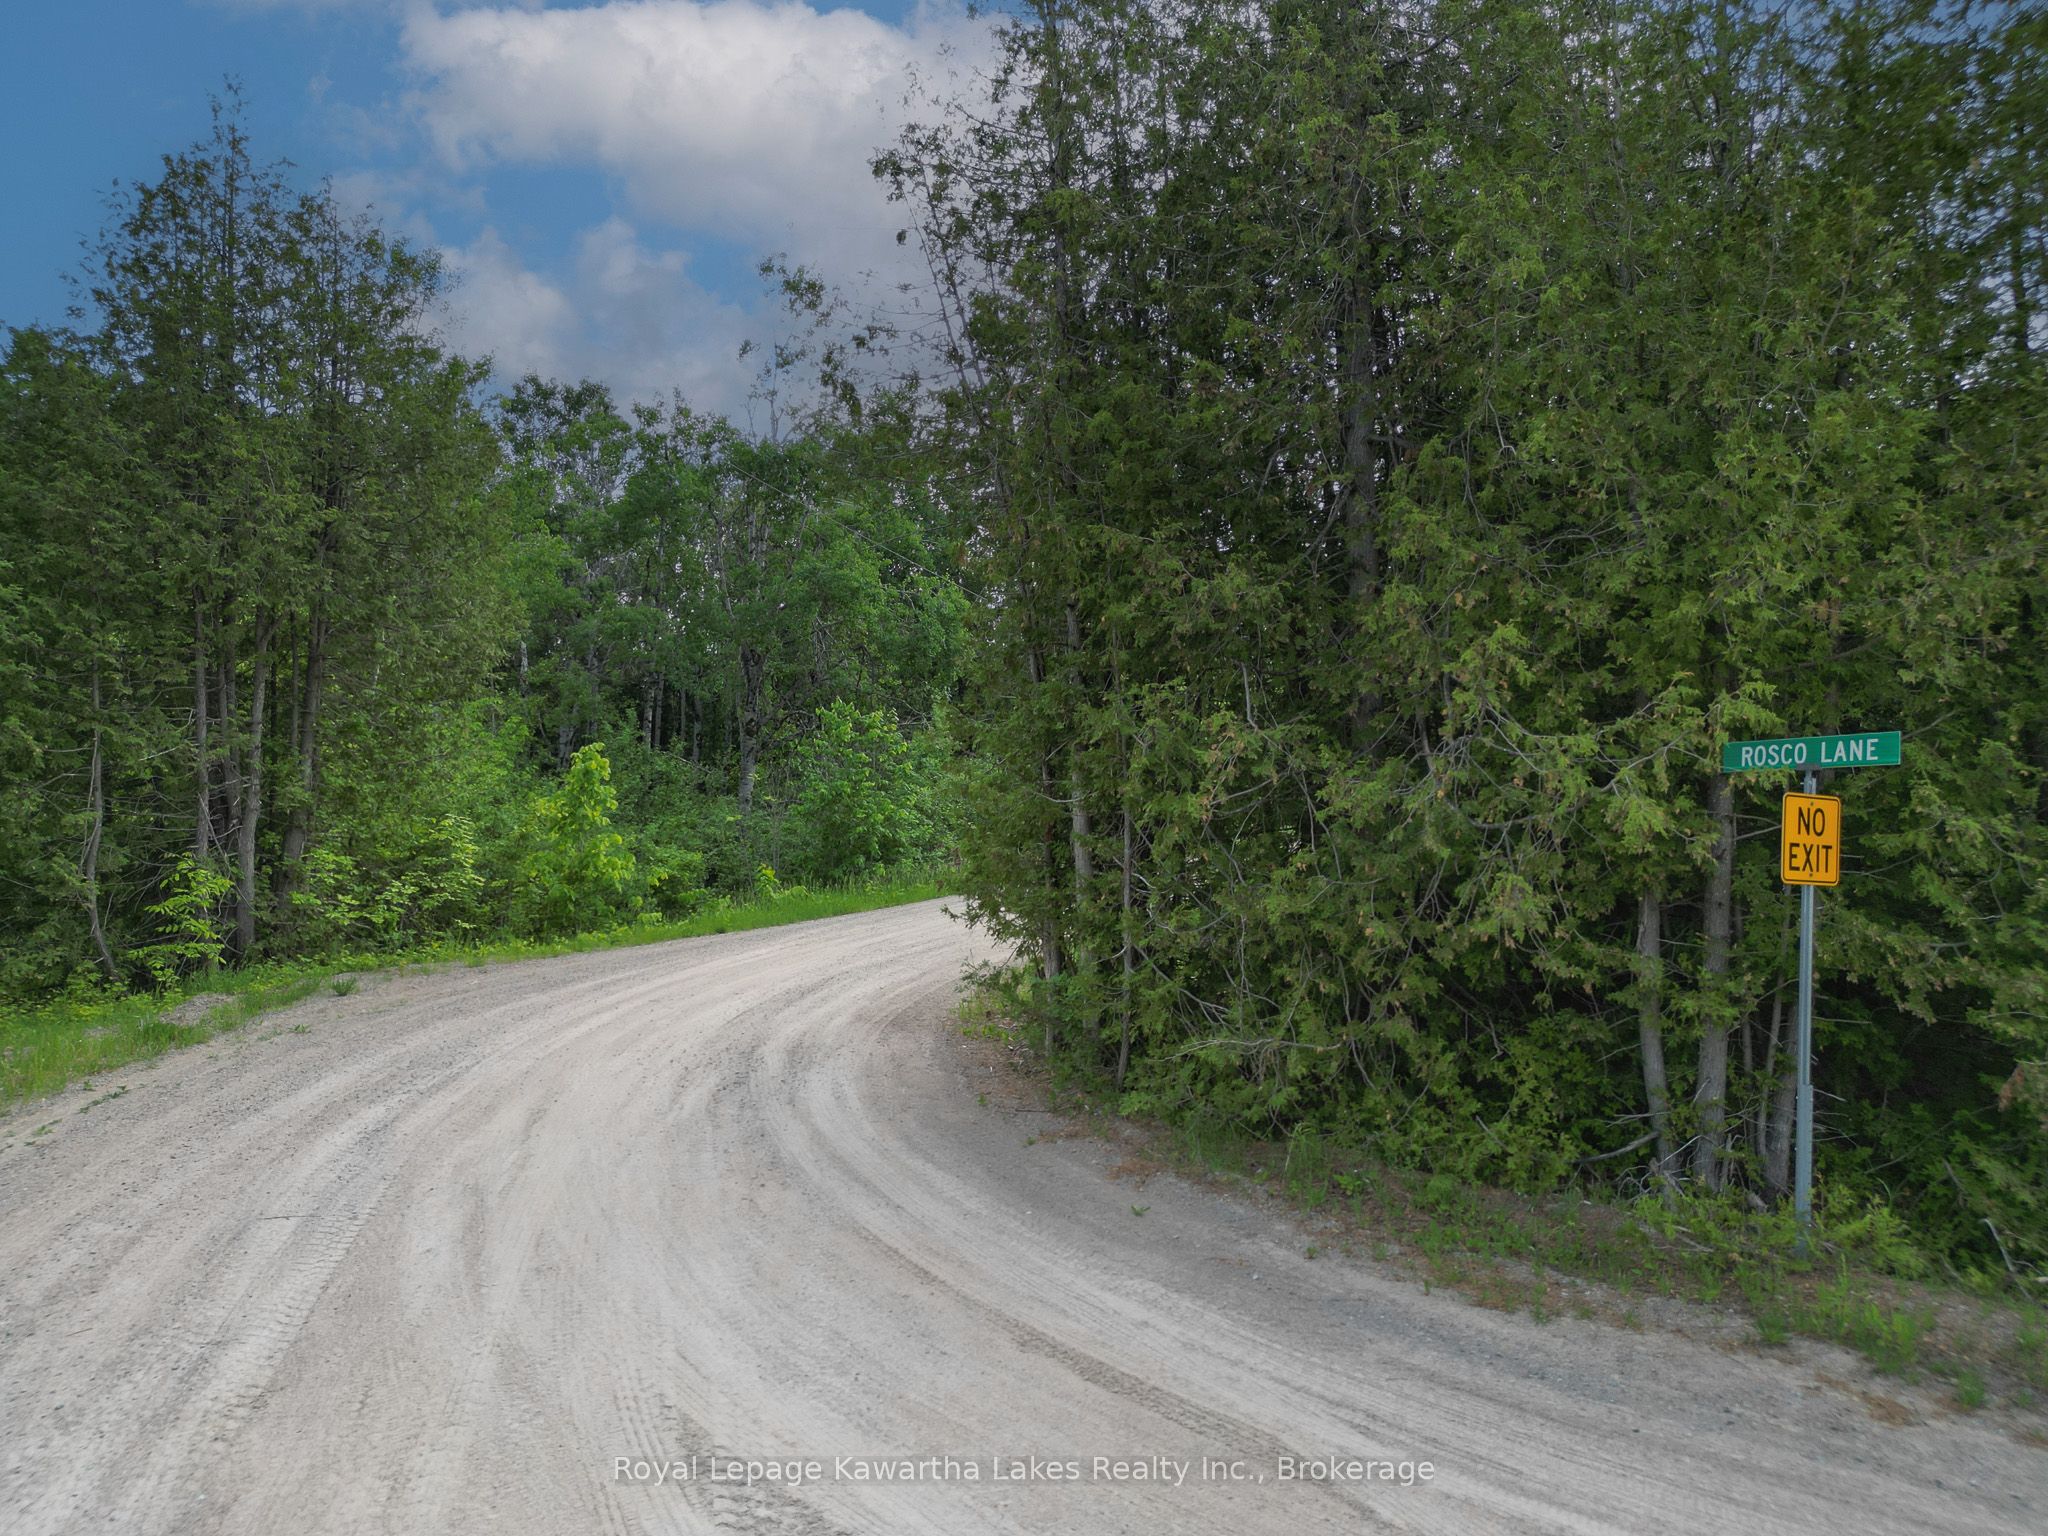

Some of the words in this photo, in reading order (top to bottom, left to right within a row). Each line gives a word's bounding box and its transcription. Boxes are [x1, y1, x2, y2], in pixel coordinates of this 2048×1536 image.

[1741, 742, 1807, 767] ROSCO
[1821, 738, 1879, 763] LANE
[1797, 806, 1825, 837] NO
[1789, 843, 1833, 873] EXIT
